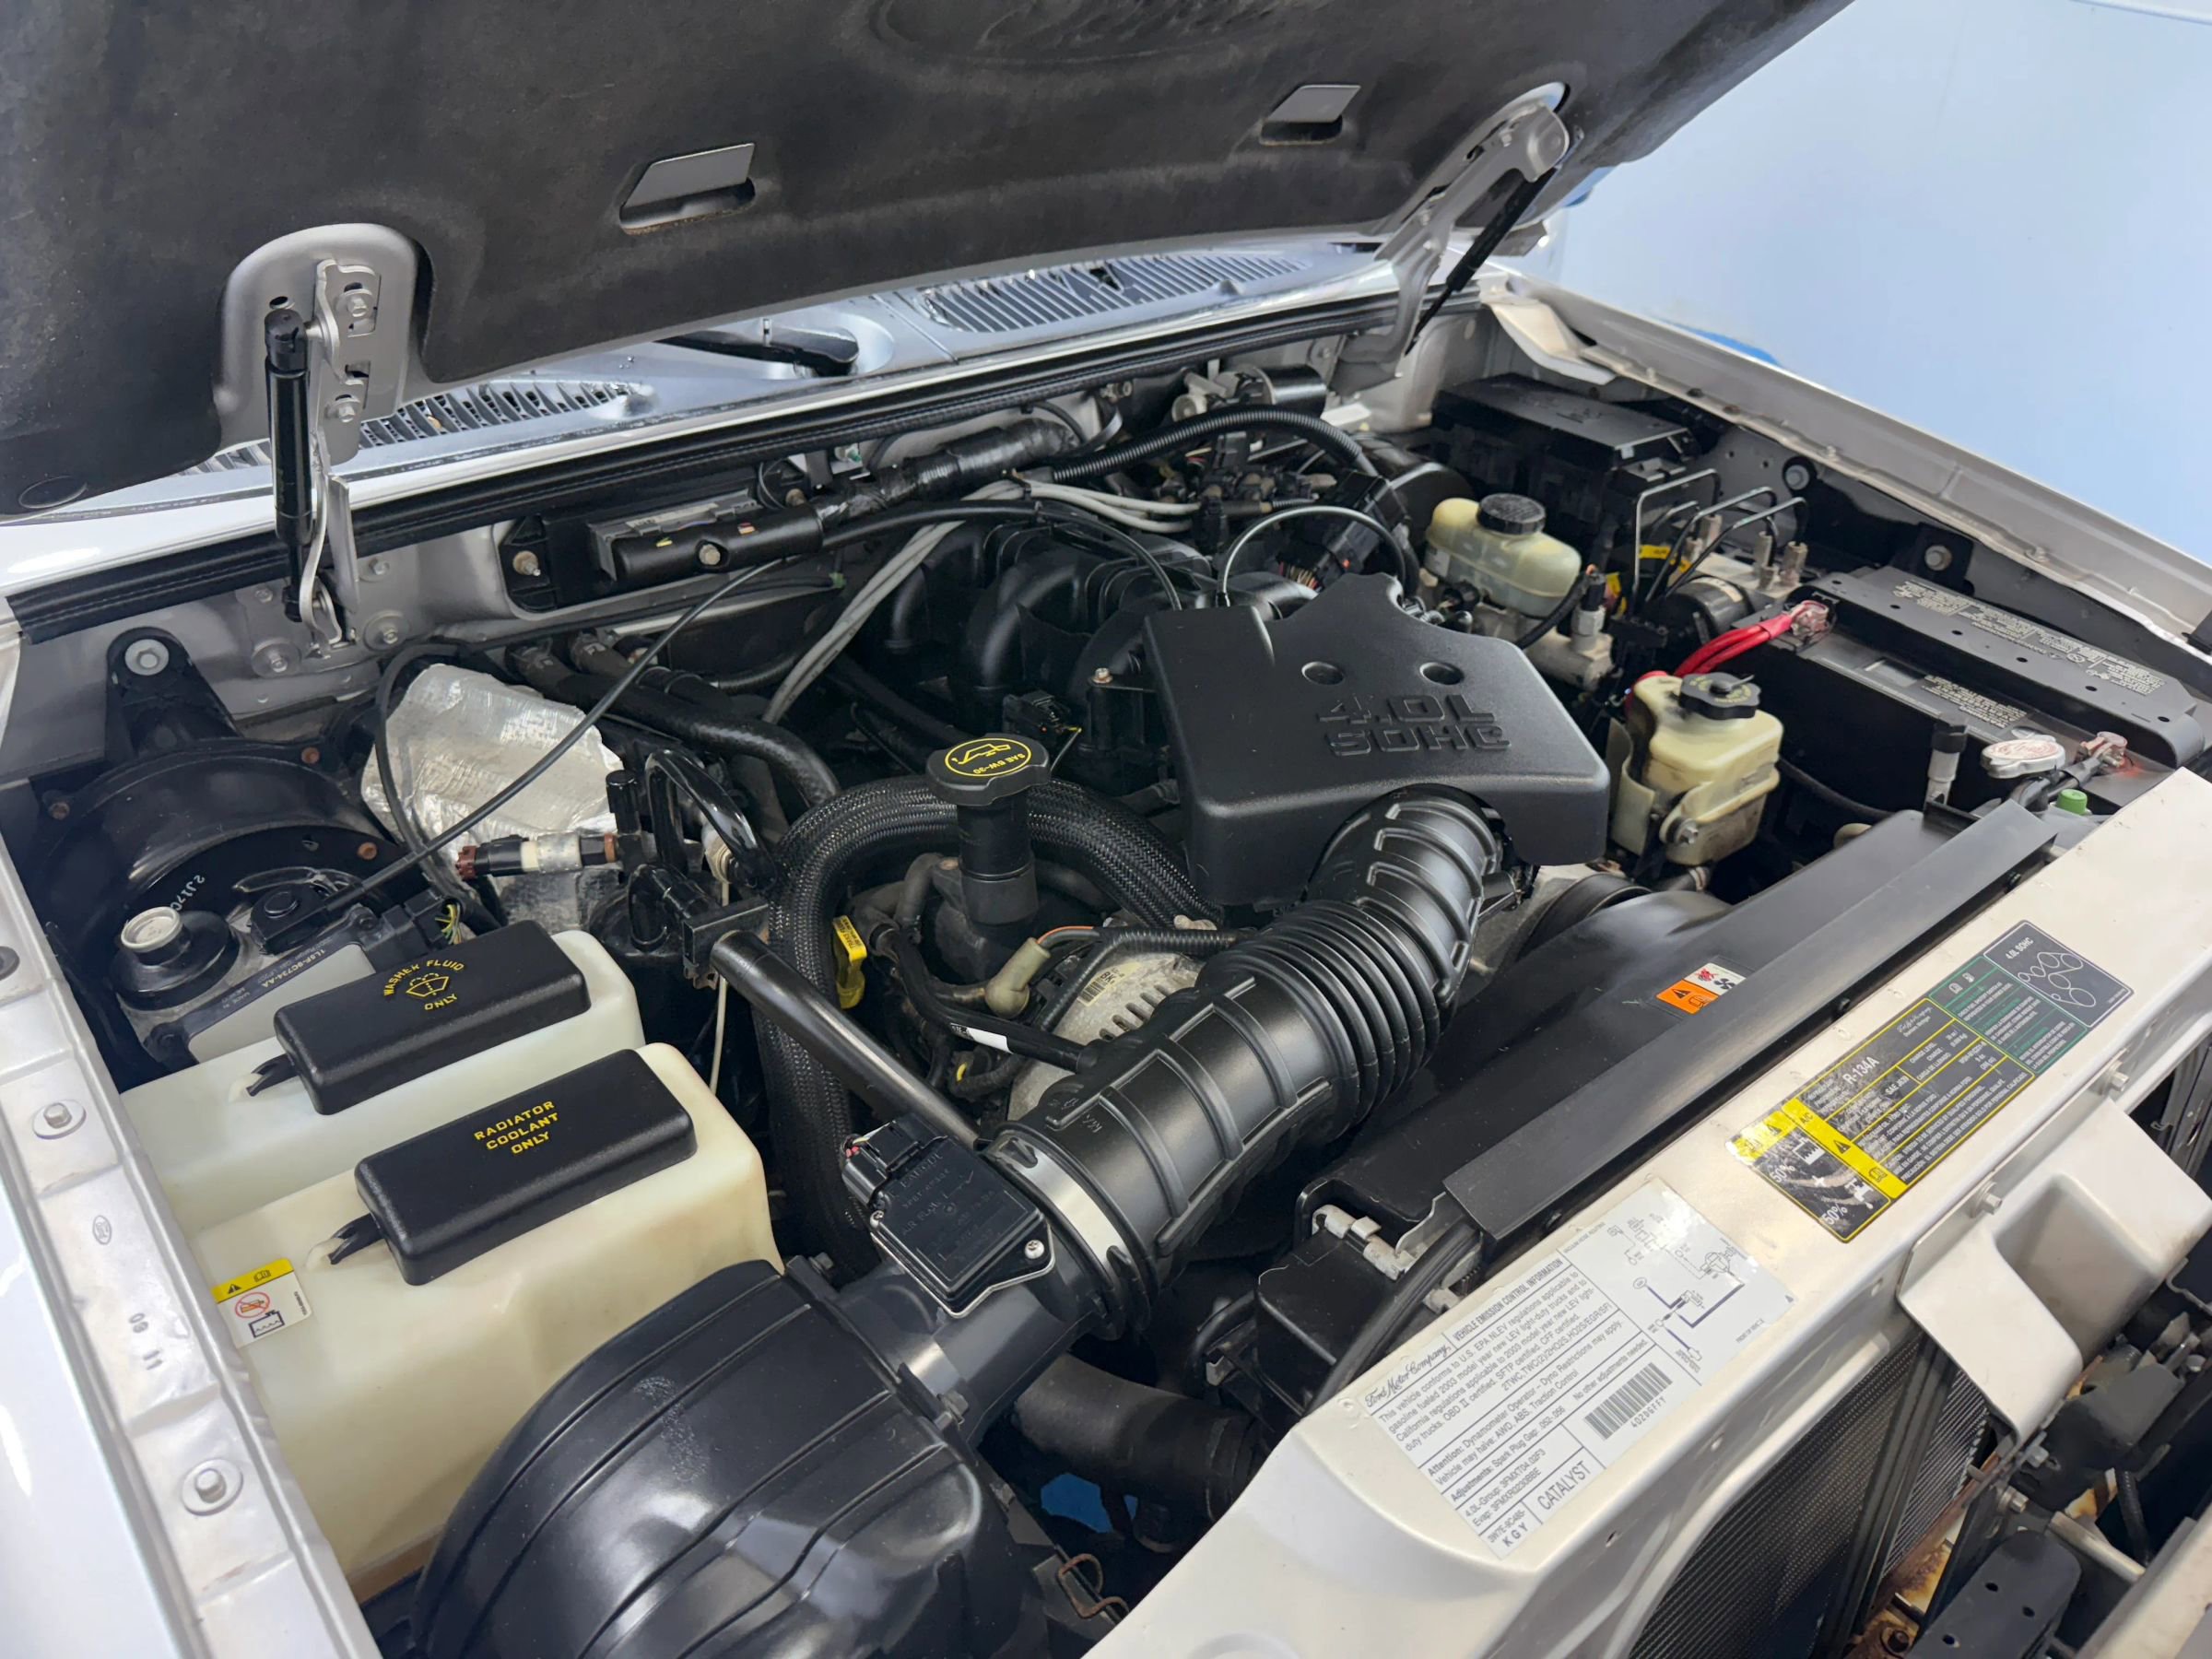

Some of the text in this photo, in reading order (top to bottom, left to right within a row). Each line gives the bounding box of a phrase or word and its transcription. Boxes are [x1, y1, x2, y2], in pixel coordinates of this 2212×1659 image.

[1317, 694, 1495, 724] 4.0L
[1325, 724, 1512, 756] SOHC
[972, 752, 1026, 774] SAE 5W-30
[2015, 937, 2034, 952] SOHC
[383, 959, 465, 996] WASHER FLUID
[424, 993, 458, 1011] ONLY
[1841, 1056, 1880, 1085] R-134A
[474, 1100, 555, 1141] RADIATOR
[486, 1112, 559, 1150] COOLANT
[1799, 1112, 1813, 1124] A/C
[511, 1131, 550, 1155] ONLY
[1820, 1201, 1848, 1226] 50%
[1453, 1259, 1563, 1341] VEHICLE EMISSION CONTROL INFORMATION
[1378, 1409, 1397, 1423] This
[1396, 1391, 1421, 1411] vehicle
[1421, 1367, 1453, 1393] conforms
[1451, 1361, 1461, 1370] to
[1474, 1337, 1490, 1351] EPA
[1488, 1323, 1508, 1341] NLEV
[1508, 1299, 1543, 1327] regulations
[1541, 1277, 1571, 1301] applicable
[1388, 1408, 1418, 1435] gasoline
[1417, 1391, 1441, 1410] fueled
[1438, 1377, 1458, 1394] 2003
[1456, 1361, 1478, 1381] model
[1477, 1350, 1493, 1366] year
[1492, 1340, 1507, 1353] new
[1505, 1328, 1521, 1343] LEV
[1519, 1308, 1550, 1332] light-duty
[1547, 1293, 1569, 1310] trucks
[1567, 1284, 1581, 1296] and
[1395, 1288, 1594, 1441] California regulations applicable to 2003 model year new LEV light-
[1365, 1386, 1387, 1408] Ford
[1382, 1372, 1409, 1399] Motor
[1405, 1437, 1422, 1452] duty
[1442, 1406, 1461, 1421] OBD
[1495, 1362, 1513, 1380] SFTP
[1539, 1331, 1554, 1346] CFF
[1428, 1446, 1465, 1477] Attention:
[1462, 1410, 1509, 1449] Dynamometer
[1507, 1387, 1536, 1412] Operator
[1539, 1371, 1559, 1386] Dyno
[1556, 1344, 1594, 1373] Restrictions
[1591, 1334, 1606, 1346] may
[1435, 1464, 1464, 1486] Vehicle
[1462, 1451, 1478, 1466] may
[1475, 1437, 1497, 1454] have:
[1529, 1387, 1557, 1409] Traction
[1554, 1369, 1579, 1390] Control
[1451, 1465, 1494, 1502] Adjustments:
[1491, 1451, 1512, 1468] Spark
[1509, 1440, 1527, 1453] Plug
[1523, 1429, 1539, 1441] Gap:
[1572, 1392, 1584, 1401] No
[1583, 1380, 1597, 1394] other
[1596, 1355, 1629, 1382] adjustments
[1537, 1460, 1591, 1511] CATALYST
[1472, 1510, 1492, 1527] Evap:
